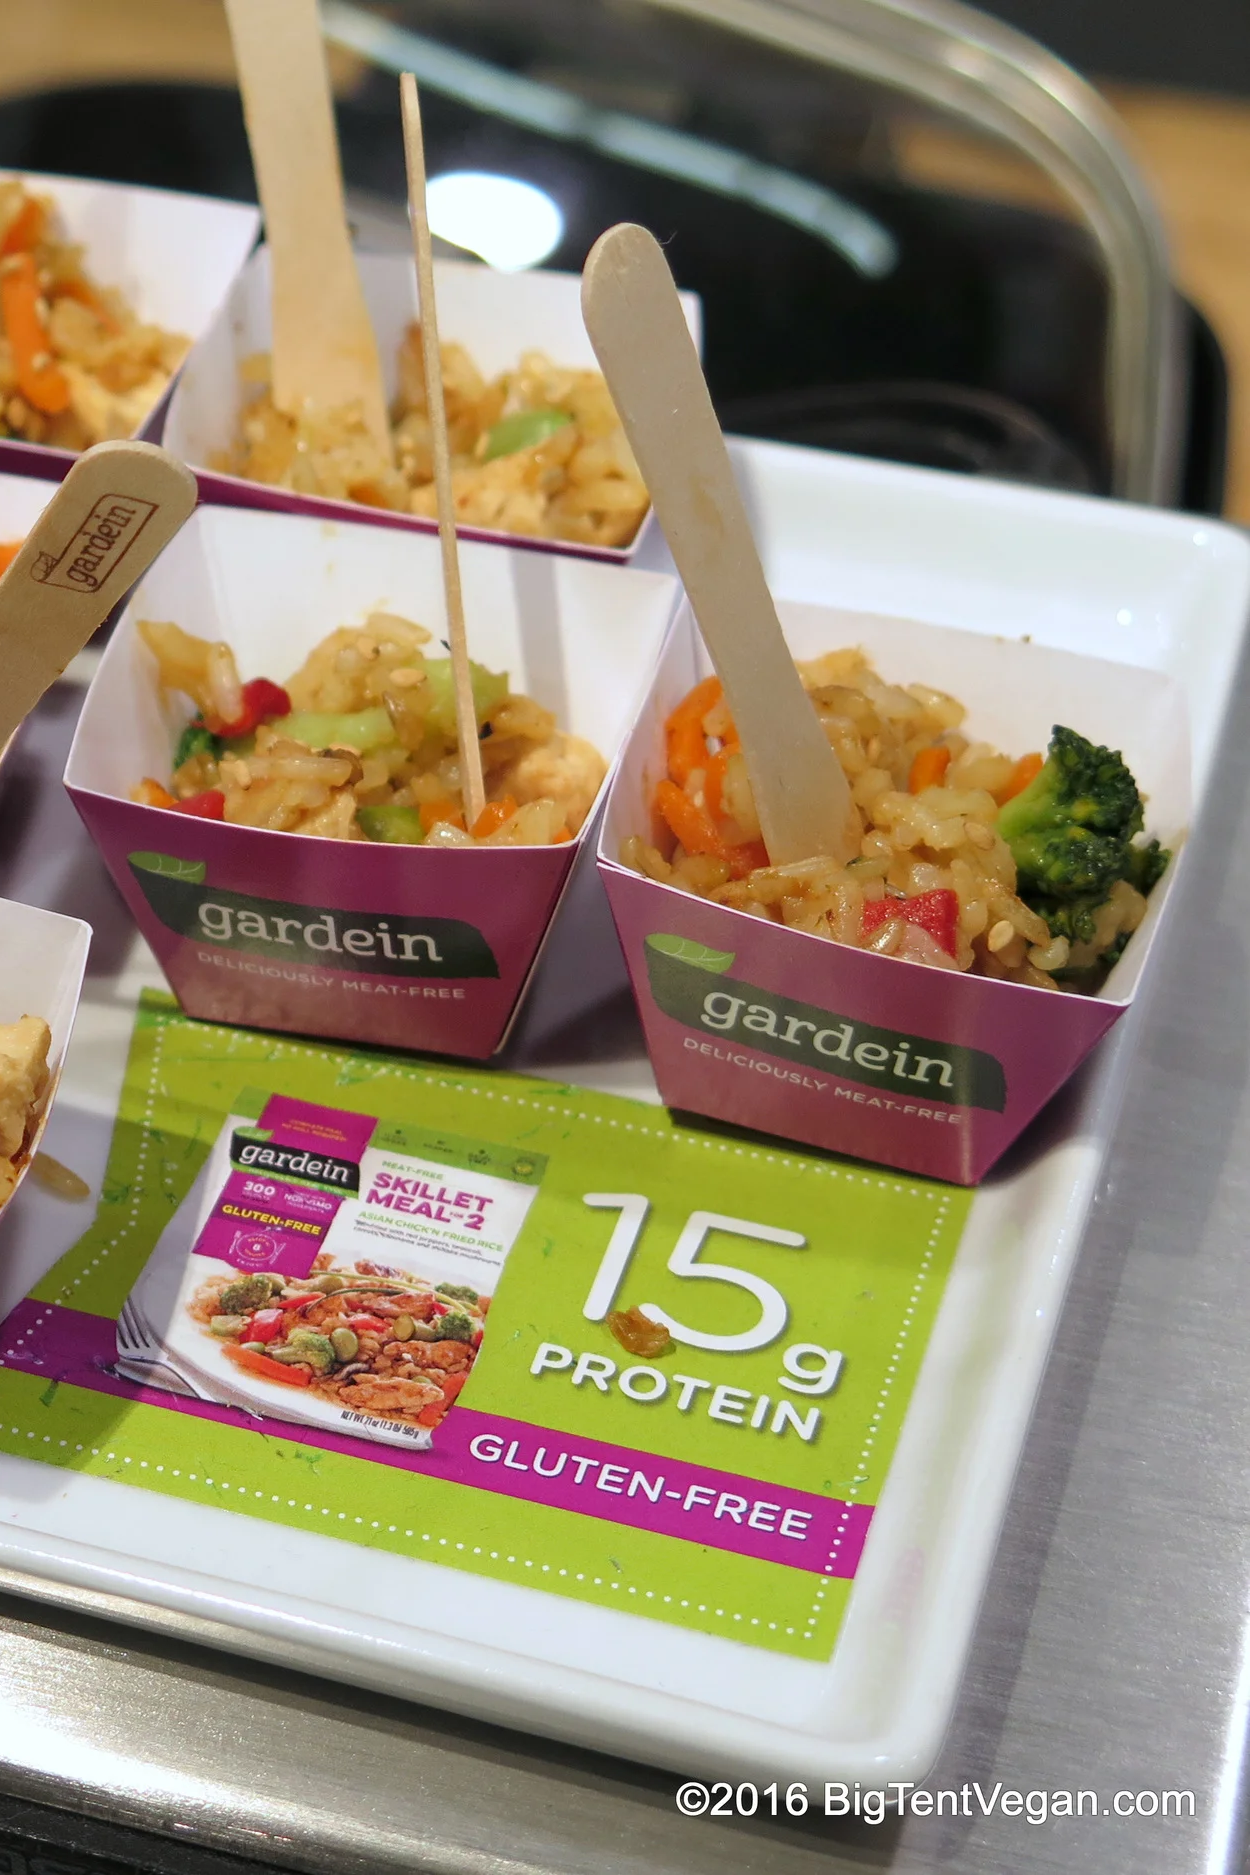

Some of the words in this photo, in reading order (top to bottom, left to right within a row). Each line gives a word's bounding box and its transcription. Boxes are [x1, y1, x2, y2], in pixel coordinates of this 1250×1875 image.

[66, 505, 137, 588] gardein
[198, 901, 443, 963] gardein
[197, 951, 335, 989] DELICIOUSLY
[342, 979, 466, 1000] MEAT-FREE
[701, 991, 954, 1088] gardein
[683, 1037, 830, 1092] DELICIOUSLY
[834, 1086, 964, 1125] MEAT-FREE
[239, 1144, 350, 1183] gardein
[382, 1160, 445, 1181] MEAT-FREE
[243, 1181, 276, 1196] 300
[365, 1189, 452, 1223] MEAL
[463, 1213, 486, 1231] 2
[373, 1172, 494, 1213] SKILLET
[222, 1204, 322, 1237] GLUTEN-FREE
[358, 1210, 395, 1226] ASIAN
[442, 1231, 476, 1246] FRIED
[477, 1240, 505, 1252] RICE
[529, 1341, 822, 1442] PROTEIN
[468, 1432, 814, 1541] GLUTEN-FREE
